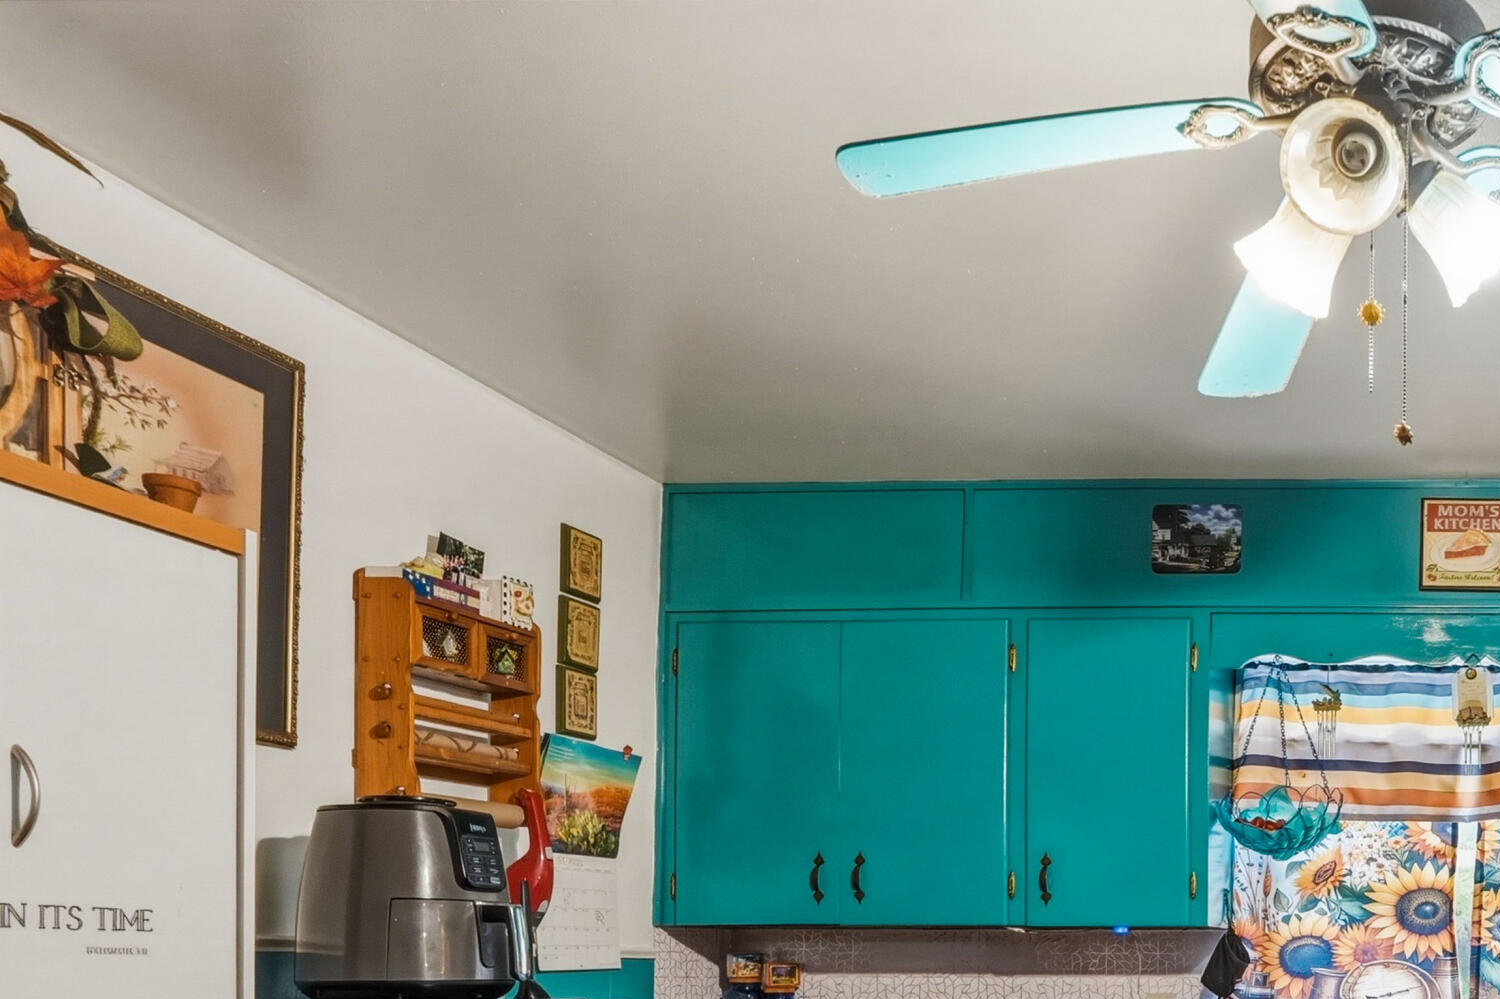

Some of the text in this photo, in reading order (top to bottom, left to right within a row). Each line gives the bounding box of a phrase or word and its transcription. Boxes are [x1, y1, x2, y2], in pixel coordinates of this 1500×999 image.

[1437, 505, 1500, 517] MOM'S
[0, 903, 154, 932] IN ITS TIME
